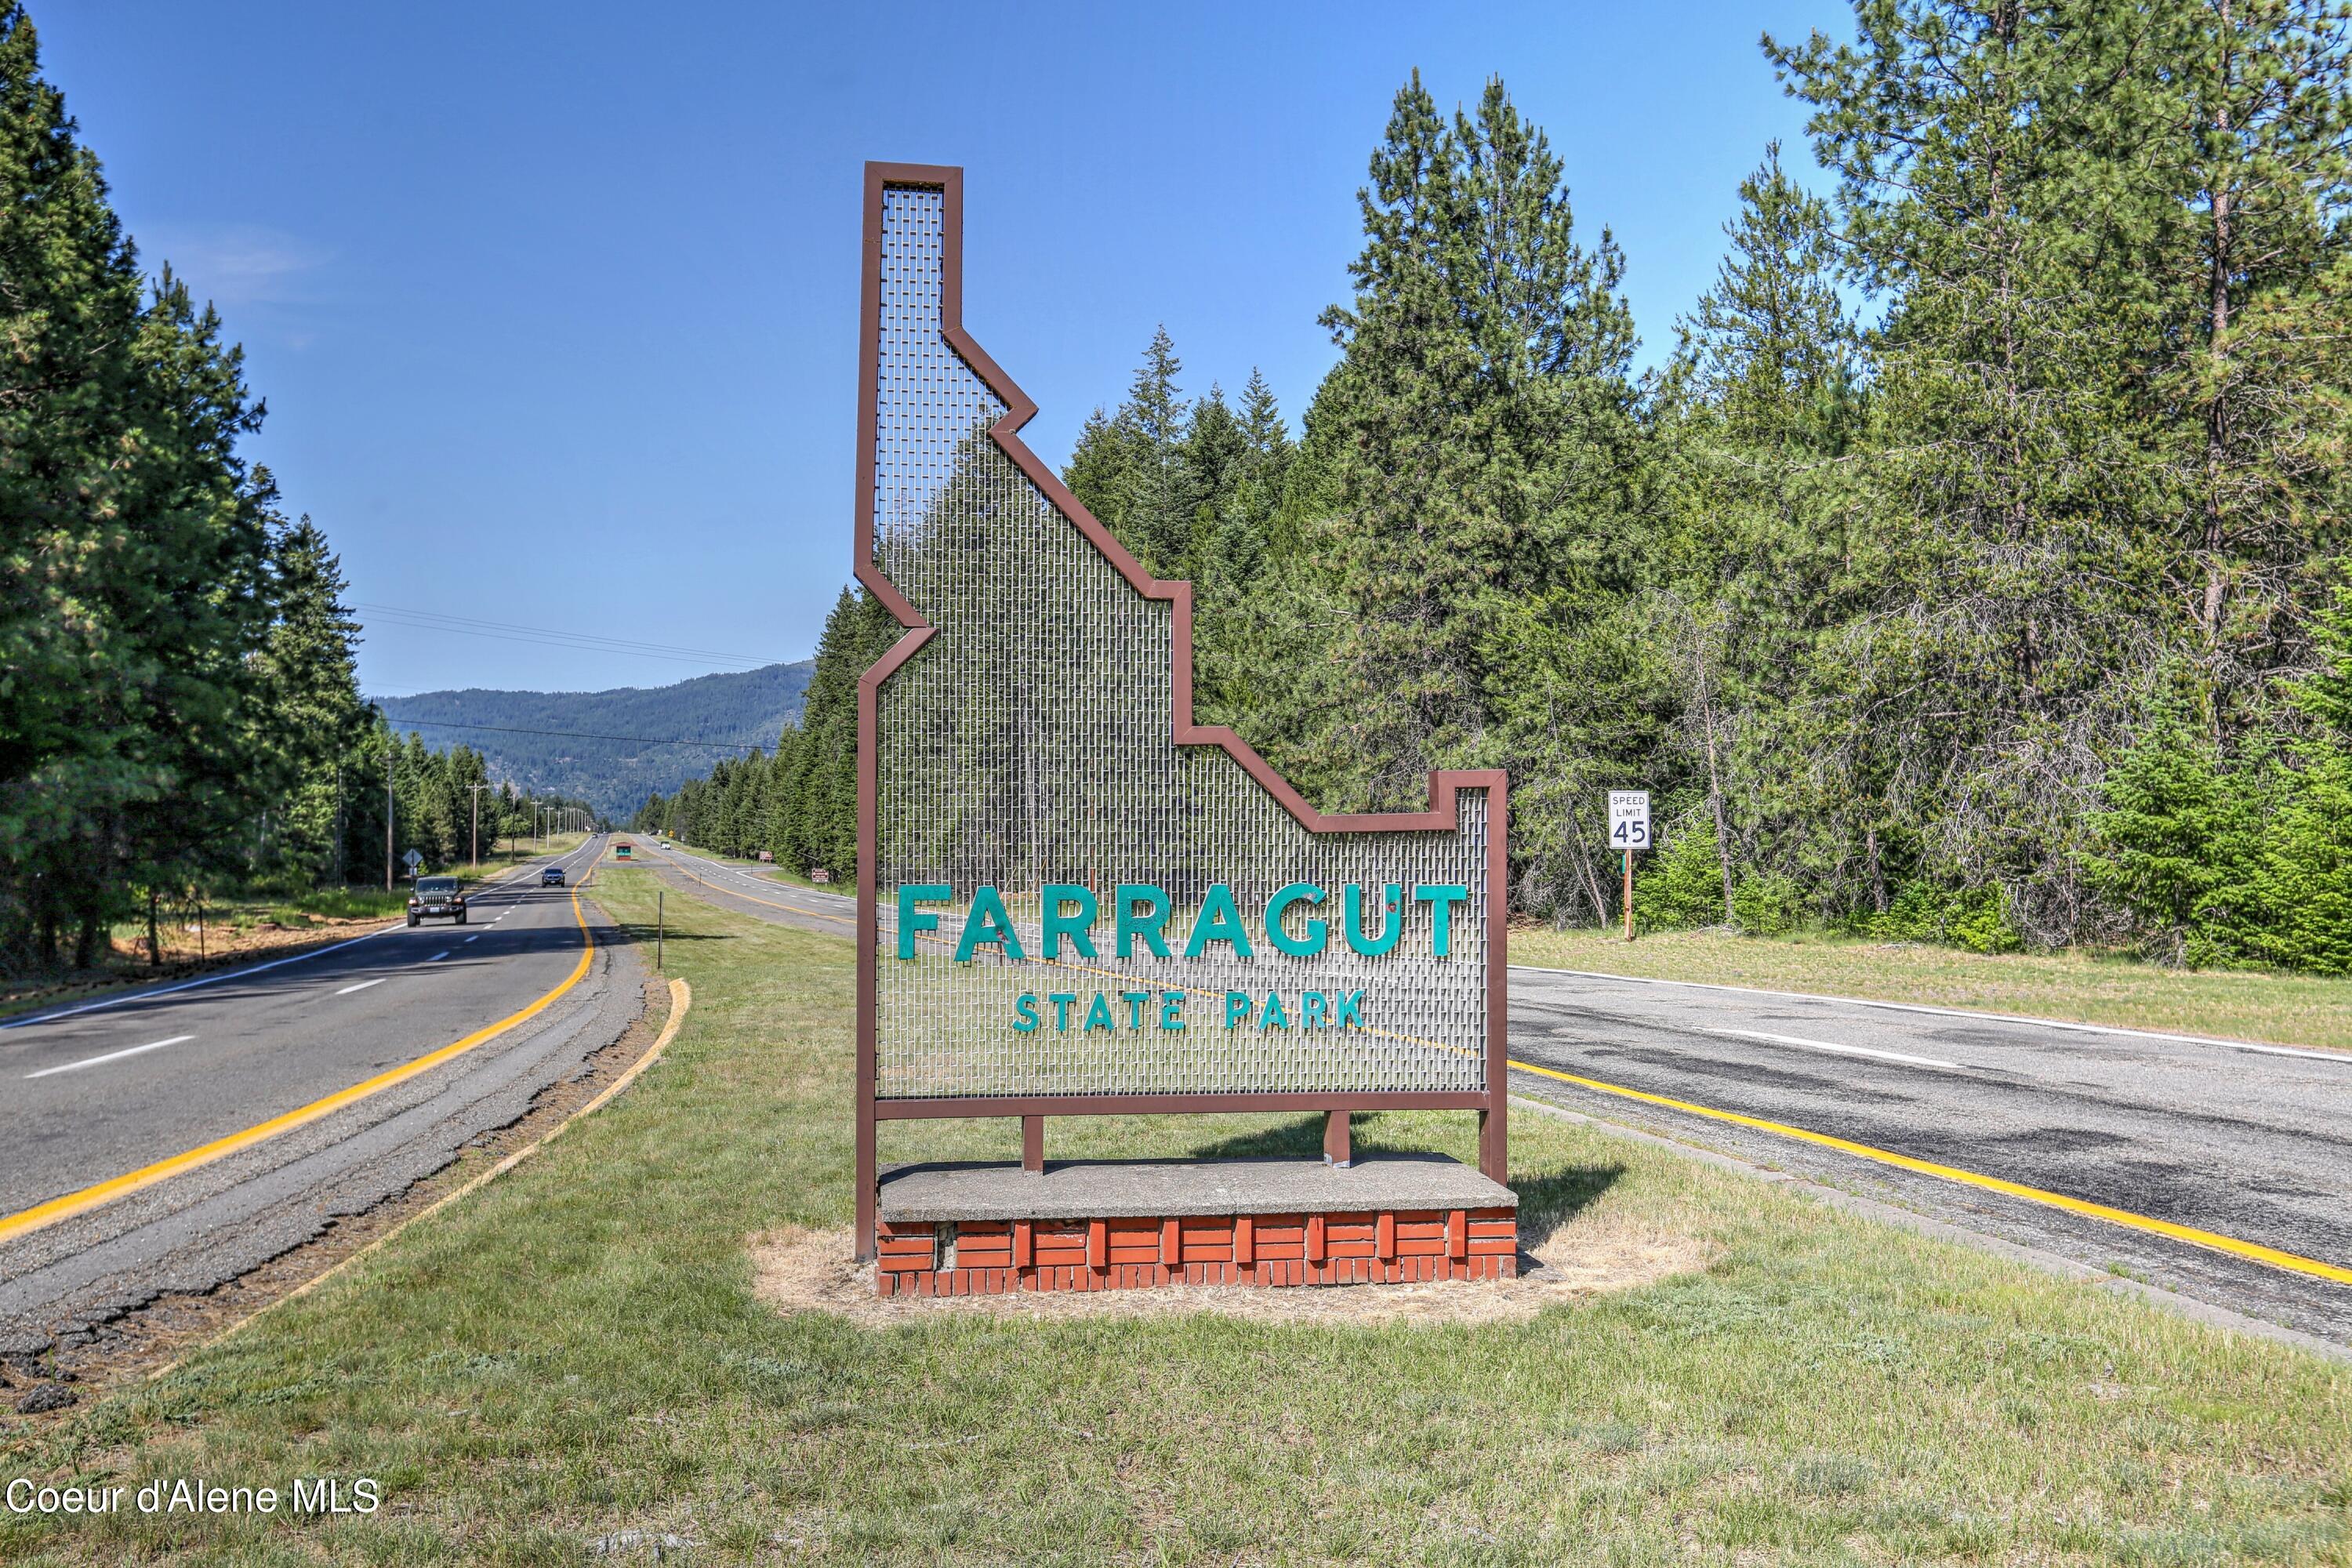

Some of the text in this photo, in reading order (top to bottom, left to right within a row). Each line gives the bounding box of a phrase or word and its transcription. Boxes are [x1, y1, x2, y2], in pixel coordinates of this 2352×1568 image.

[1613, 797, 1645, 805] SPEED
[1616, 808, 1642, 817] LIMIT
[1613, 821, 1646, 843] 45
[898, 883, 1467, 961] FARRAGUT
[1013, 989, 1365, 1032] STATE PARK
